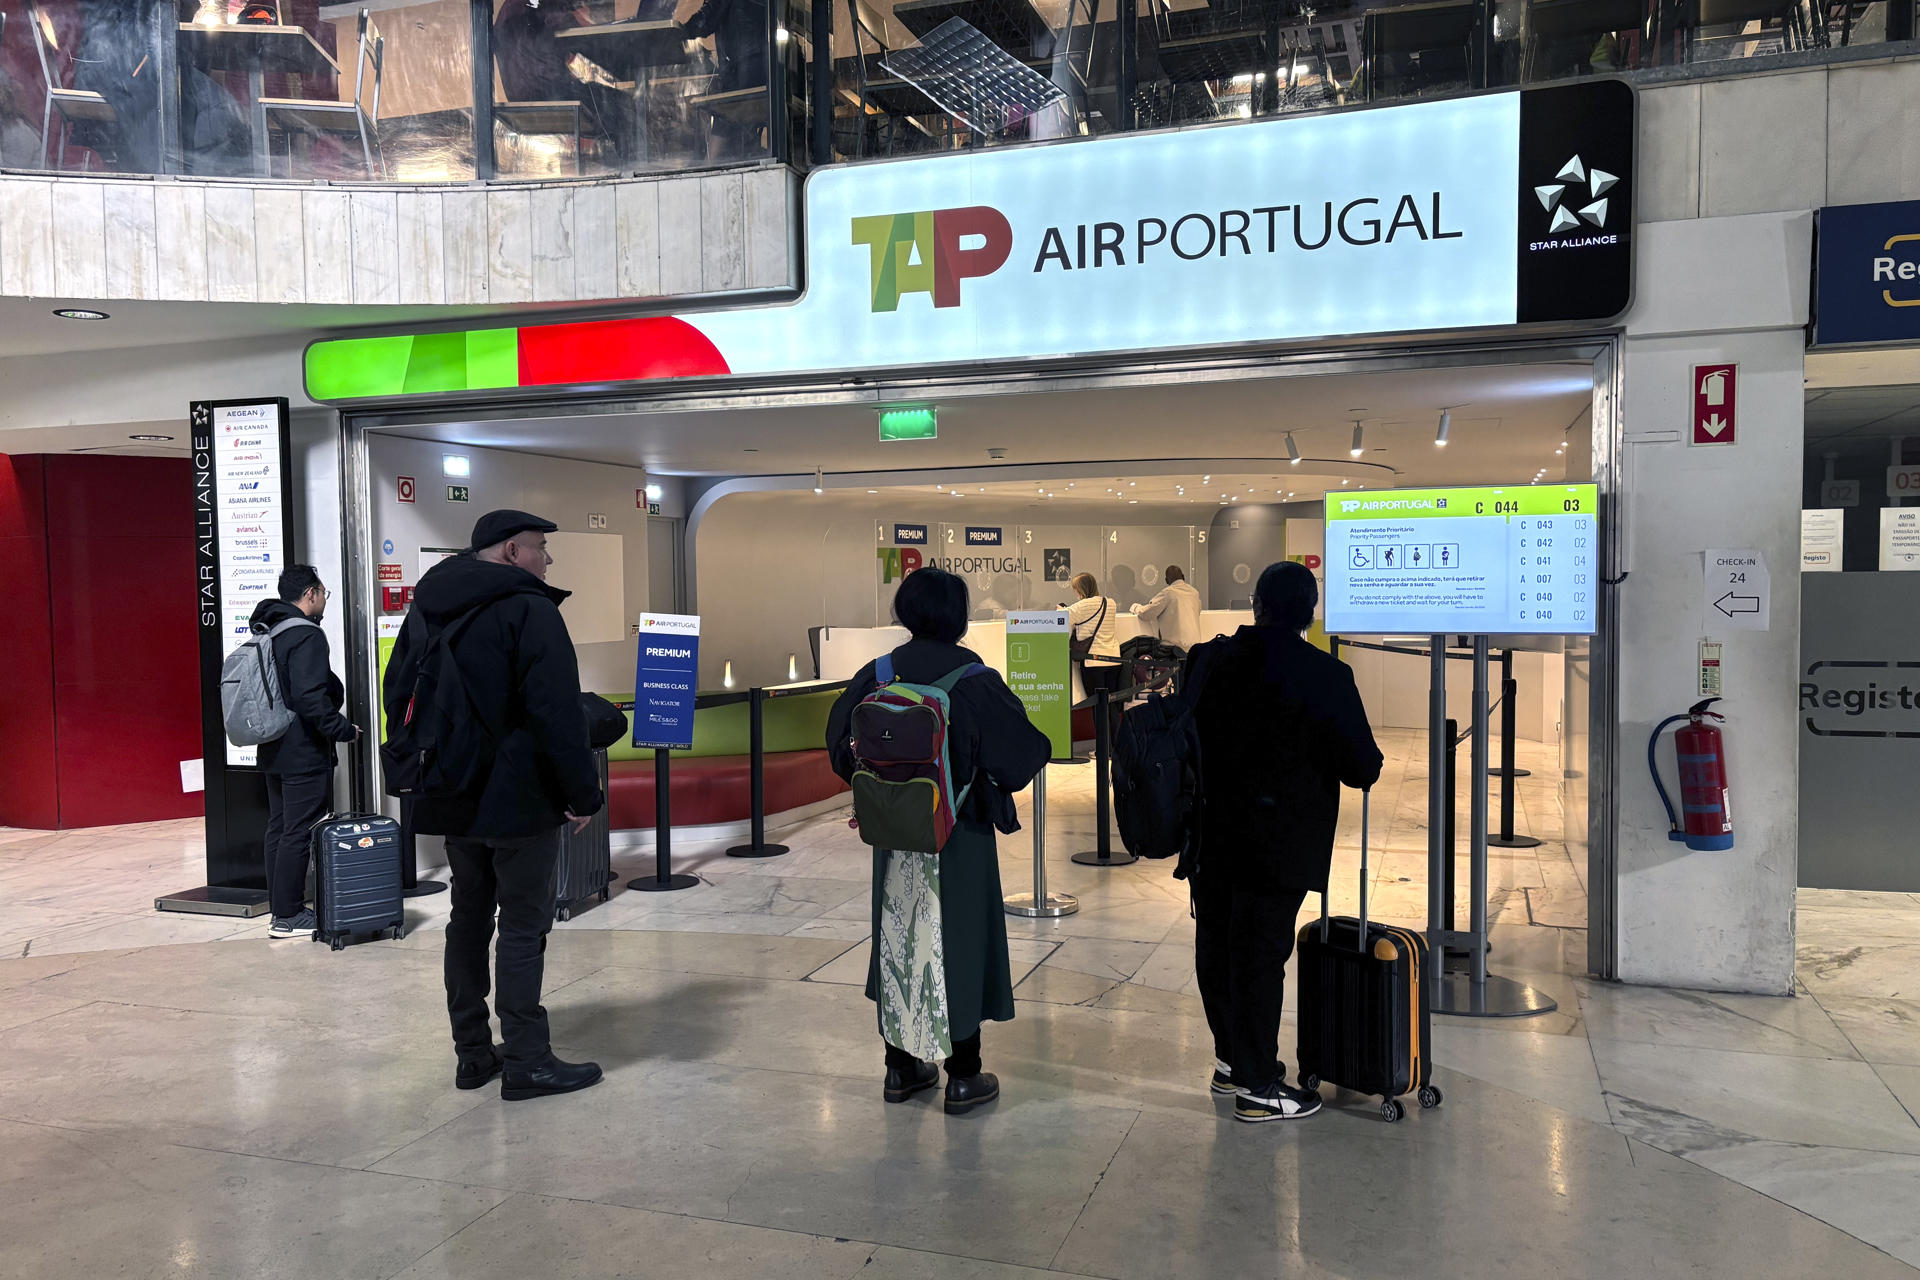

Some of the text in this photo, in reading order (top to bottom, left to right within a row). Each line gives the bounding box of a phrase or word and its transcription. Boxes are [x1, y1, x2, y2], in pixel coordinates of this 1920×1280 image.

[1530, 235, 1617, 251] STAR ALLIANCE
[851, 205, 1013, 313] TAP
[1895, 472, 1920, 489] 03
[1828, 486, 1852, 501] 02
[1476, 502, 1483, 514] C
[1495, 501, 1519, 514] 044
[1564, 499, 1579, 511] 03
[1520, 519, 1586, 530] C 043 03
[195, 436, 216, 626] STAR ALLIANCE
[879, 525, 884, 540] 1
[898, 529, 924, 540] PREMIUM
[947, 529, 954, 543] 2
[970, 531, 998, 541] PREMIUM
[1025, 530, 1032, 544] 3
[1109, 531, 1118, 544] 4
[1197, 531, 1206, 543] 5
[1520, 537, 1586, 548] C 042 02
[877, 547, 923, 584] TAP
[1520, 555, 1586, 566] C 041 04
[1716, 558, 1756, 566] CHECK-IN
[1520, 573, 1586, 584] A 007 03
[1729, 573, 1746, 584] 24
[1520, 591, 1586, 602] C 040 02
[1520, 610, 1586, 621] C 040 02
[646, 647, 691, 658] PREMIUM
[1010, 671, 1037, 680] Retire
[1036, 682, 1064, 690] senha
[1041, 692, 1059, 701] take
